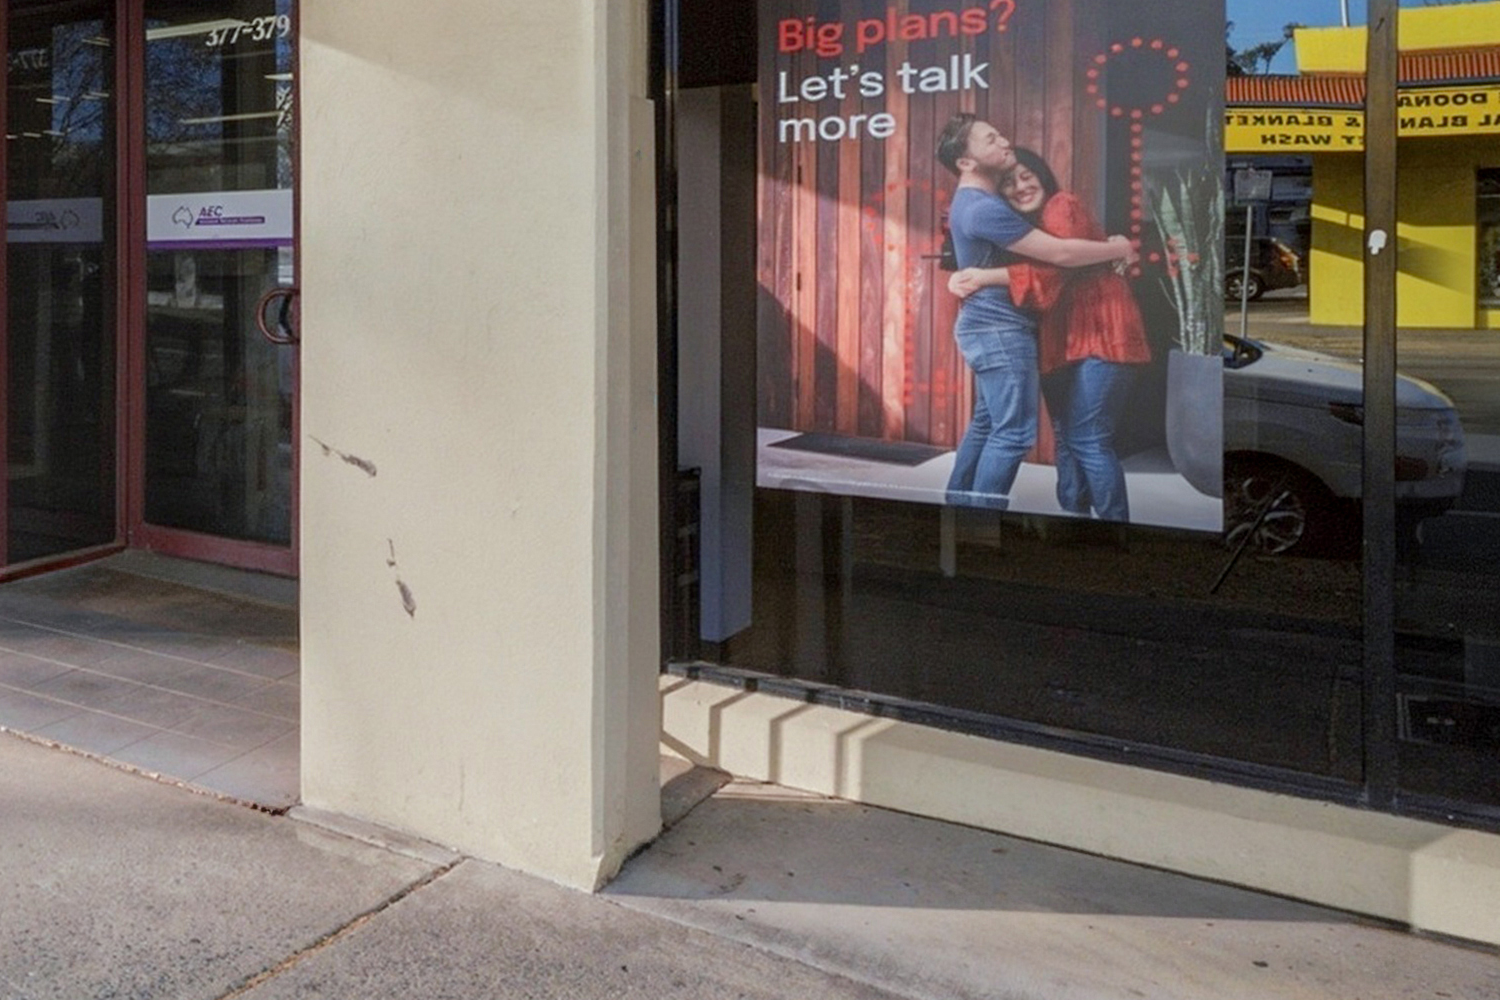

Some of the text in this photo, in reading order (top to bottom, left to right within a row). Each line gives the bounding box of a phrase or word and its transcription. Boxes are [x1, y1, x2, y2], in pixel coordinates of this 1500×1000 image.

[205, 14, 291, 47] 377-379
[778, 15, 845, 58] Big
[778, 53, 990, 104] Let's talk
[778, 112, 897, 144] more
[199, 206, 223, 217] AEC
